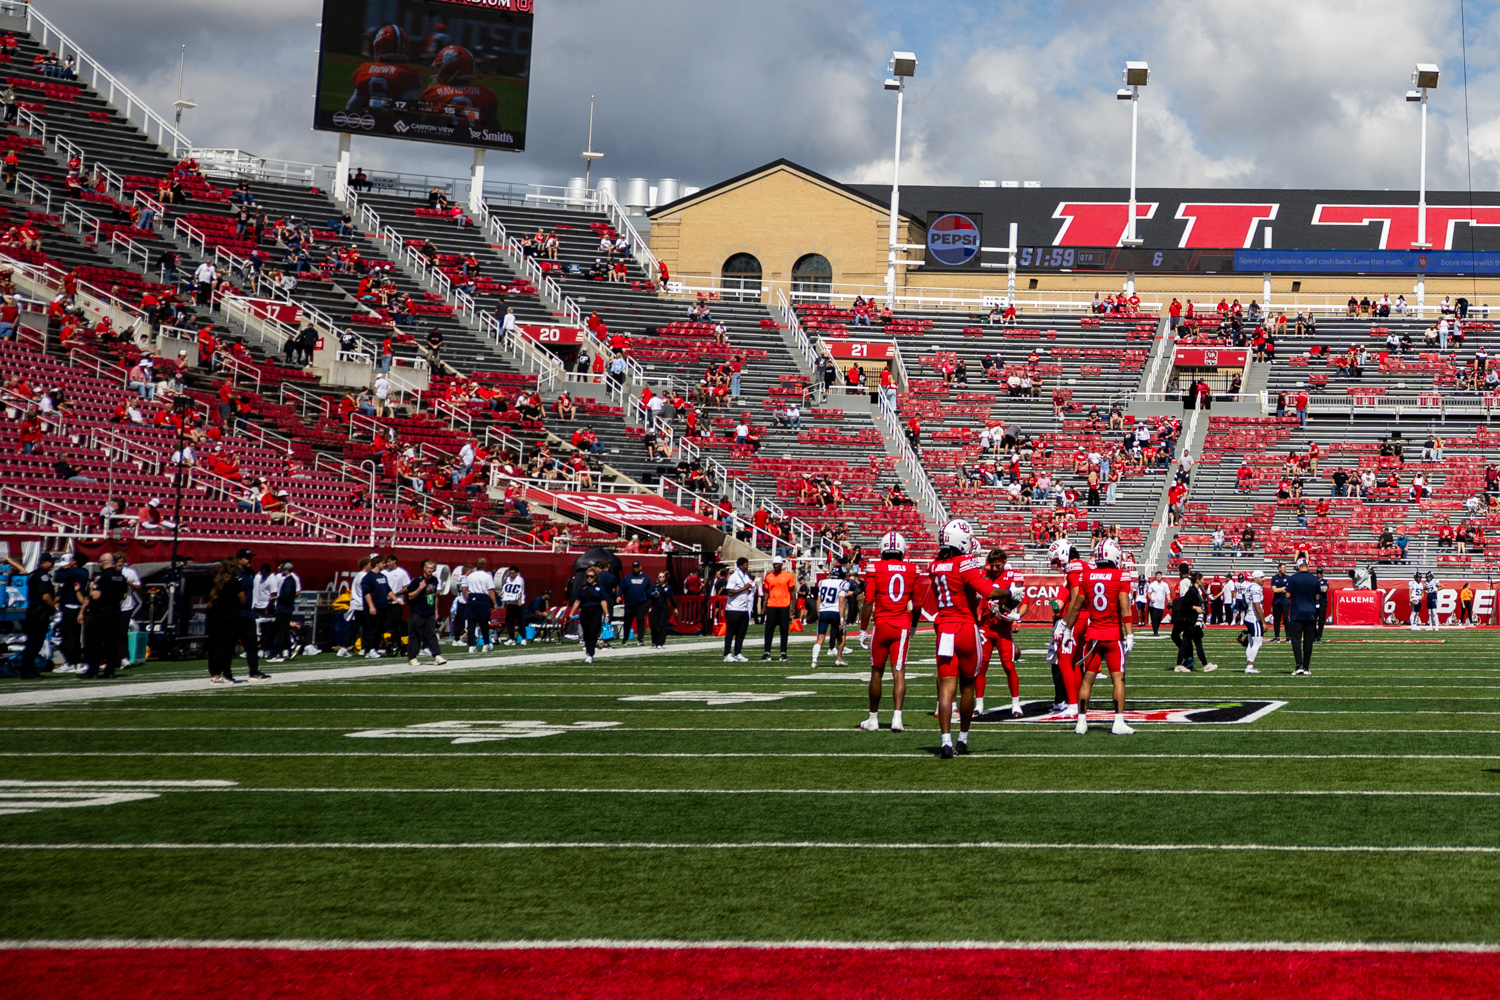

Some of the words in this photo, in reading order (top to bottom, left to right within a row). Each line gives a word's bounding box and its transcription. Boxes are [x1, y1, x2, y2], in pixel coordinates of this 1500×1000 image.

[411, 123, 437, 132] CANYON
[438, 126, 454, 134] VIEW
[482, 129, 514, 144] Smith's
[931, 233, 976, 245] PEPSI
[1020, 248, 1075, 267] 51:59
[1152, 252, 1163, 266] &
[1239, 257, 1260, 266] Spend
[1276, 257, 1303, 265] balance.
[1305, 257, 1317, 265] Get
[1318, 257, 1334, 265] cash
[1335, 257, 1352, 265] back.
[1441, 258, 1459, 266] Score
[1480, 258, 1493, 266] with
[266, 306, 280, 319] 17
[539, 328, 560, 341] 20
[851, 344, 868, 357] 21
[888, 573, 905, 602] 0
[935, 574, 954, 608] 11
[1026, 586, 1059, 598] CAN
[820, 587, 838, 604] 89
[1093, 582, 1108, 611] 8
[1339, 596, 1374, 604] ALKEME
